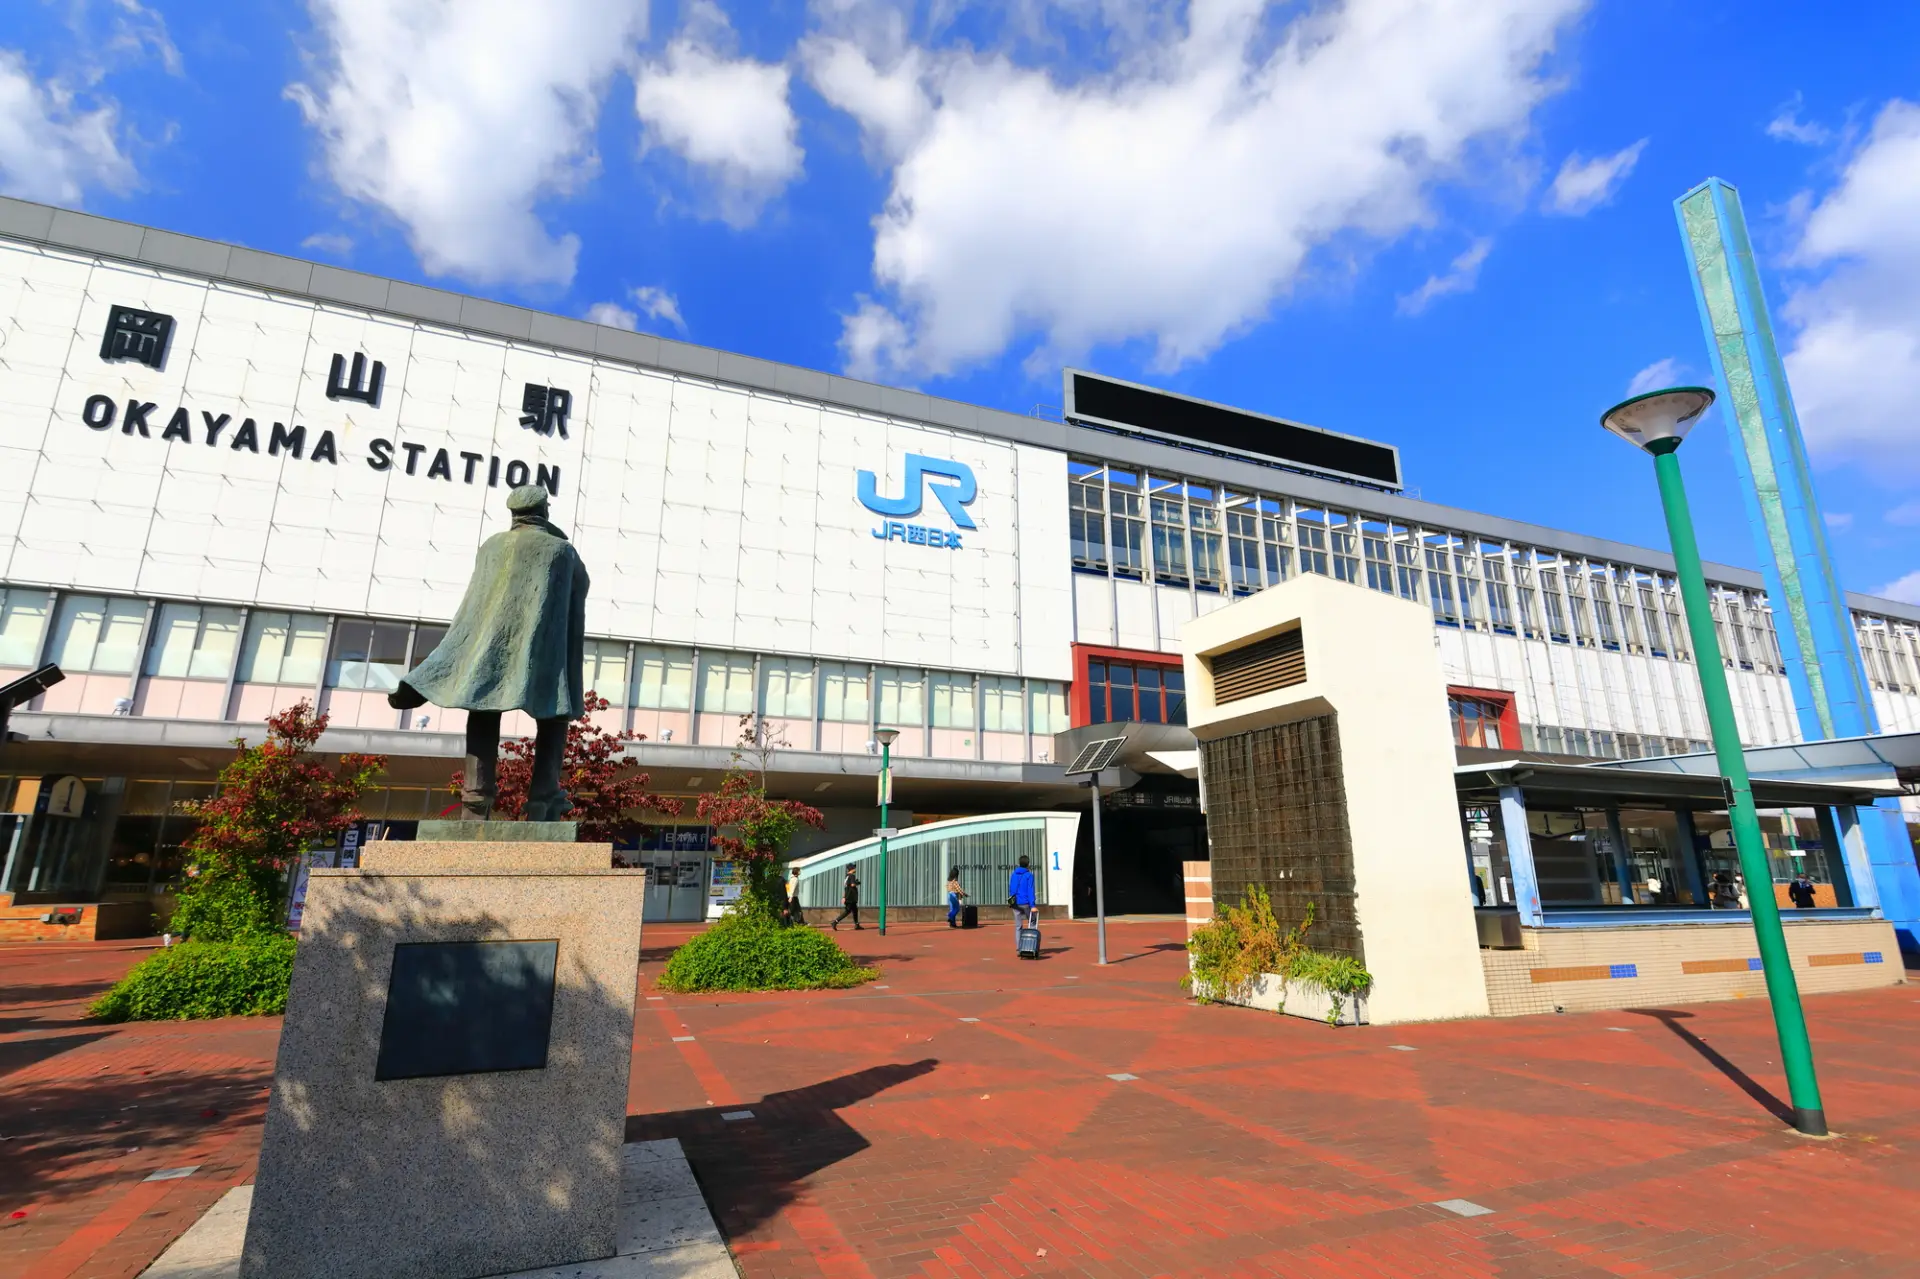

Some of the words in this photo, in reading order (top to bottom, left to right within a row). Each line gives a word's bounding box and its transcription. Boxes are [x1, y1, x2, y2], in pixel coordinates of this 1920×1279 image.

[100, 304, 572, 439] 岡山駅
[82, 394, 338, 465] OKAYAMA
[366, 438, 561, 496] STATION
[857, 452, 977, 531] JR
[872, 520, 963, 550] JR西日本
